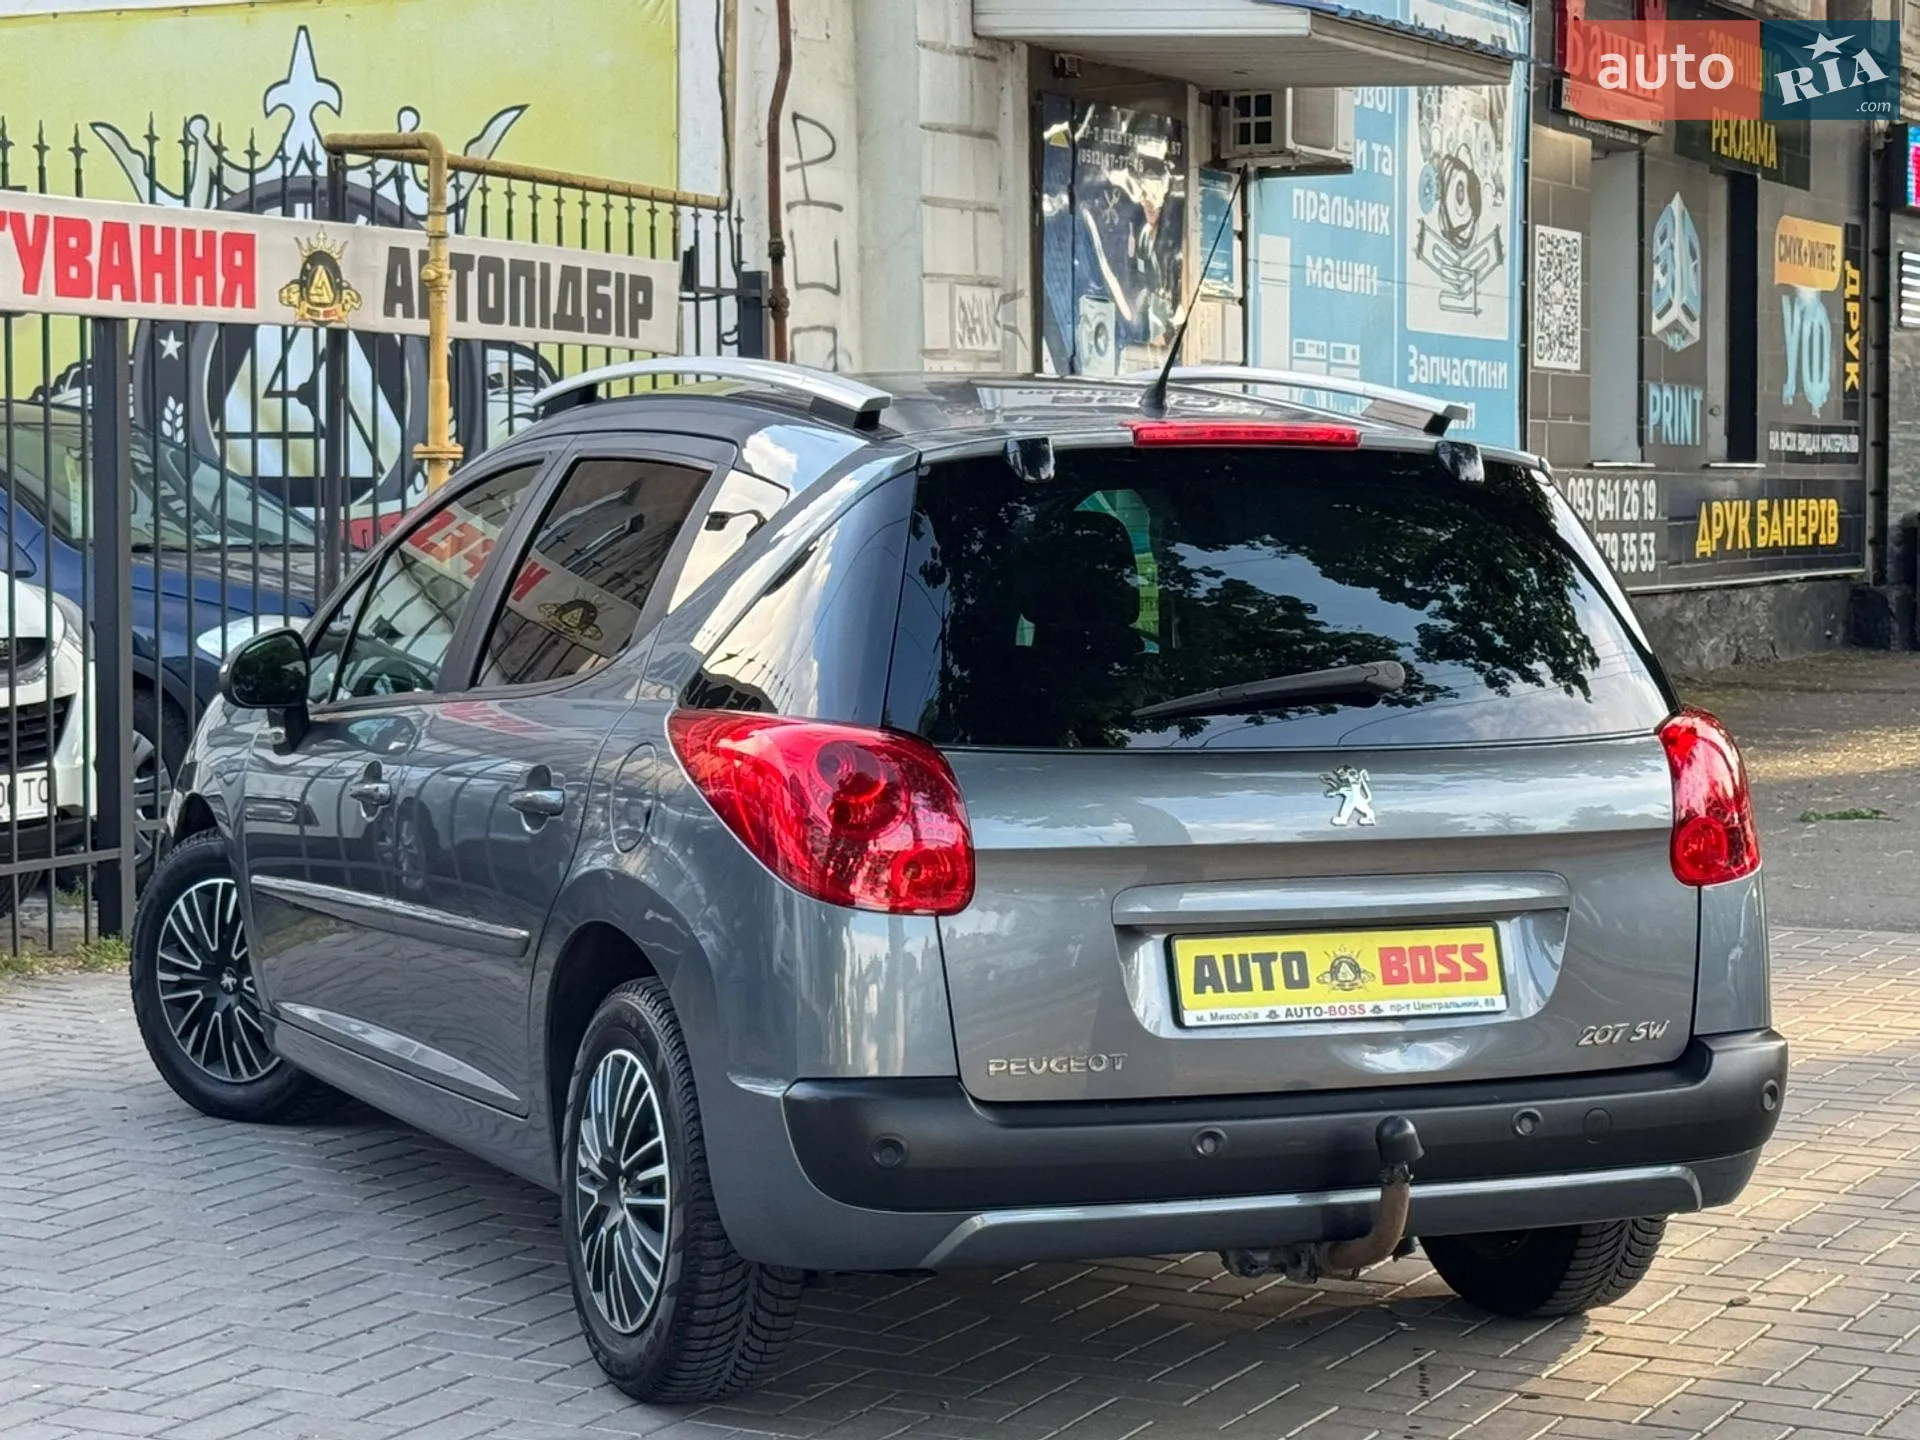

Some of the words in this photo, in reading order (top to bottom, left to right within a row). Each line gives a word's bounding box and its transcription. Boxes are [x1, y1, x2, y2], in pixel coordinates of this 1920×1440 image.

[1371, 142, 1393, 176] та
[1711, 105, 1778, 170] РЕКЛАМА
[1292, 188, 1391, 237] пральних
[1305, 255, 1379, 296] машин
[1844, 260, 1861, 393] ДРУК
[1407, 345, 1508, 390] Запчастини
[1648, 384, 1702, 446] PRINT
[1567, 477, 1594, 521] 093
[1597, 478, 1620, 521] 641
[1623, 478, 1640, 521] 26
[1642, 478, 1657, 521] 19
[1695, 500, 1752, 559] ДРУК
[1756, 498, 1839, 549] БАНЕРІВ
[1621, 532, 1638, 573] 35
[1640, 532, 1656, 573] 53
[1193, 950, 1311, 996] AUTO
[1377, 943, 1489, 987] BOSS
[1284, 1003, 1367, 1019] AUTO-BOSS
[1576, 1022, 1631, 1047] 207
[1628, 1019, 1671, 1042] SW
[987, 1053, 1128, 1077] PEUGEOT
